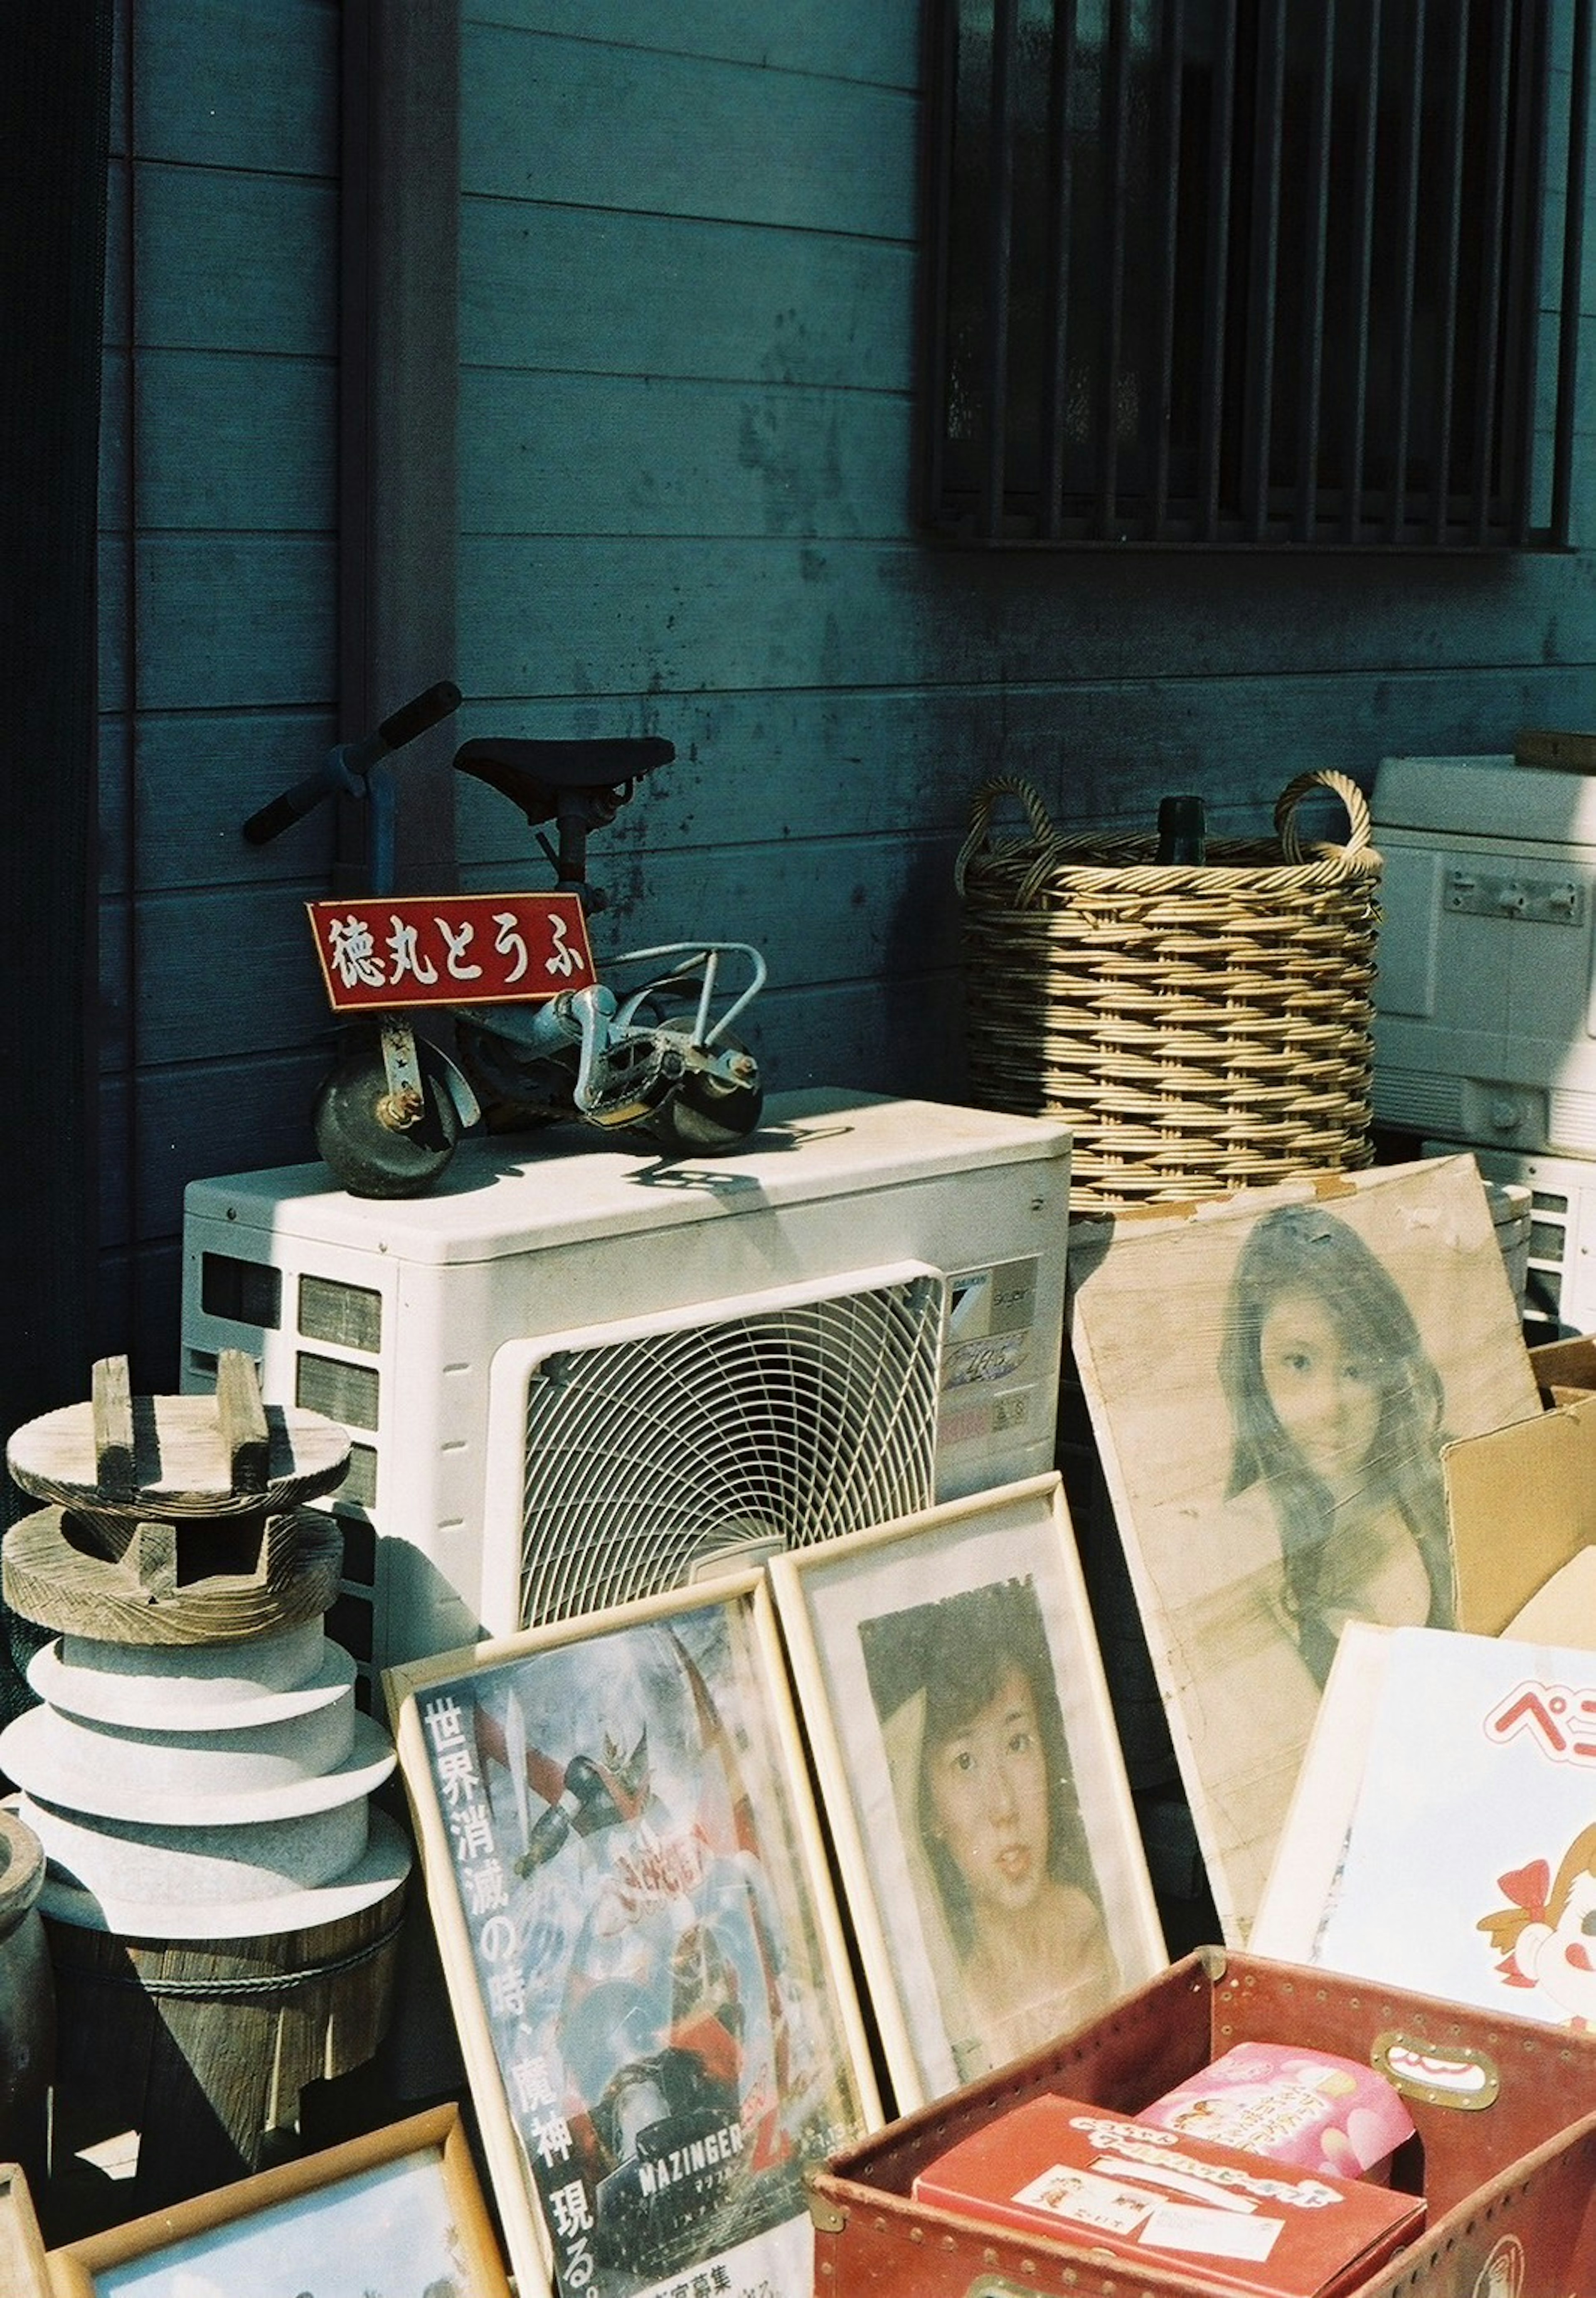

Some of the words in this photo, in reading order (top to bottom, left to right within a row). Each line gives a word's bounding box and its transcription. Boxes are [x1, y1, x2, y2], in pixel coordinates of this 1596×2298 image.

[329, 913, 584, 988] 徳丸とうふ
[638, 2122, 744, 2197] MAZINGER
